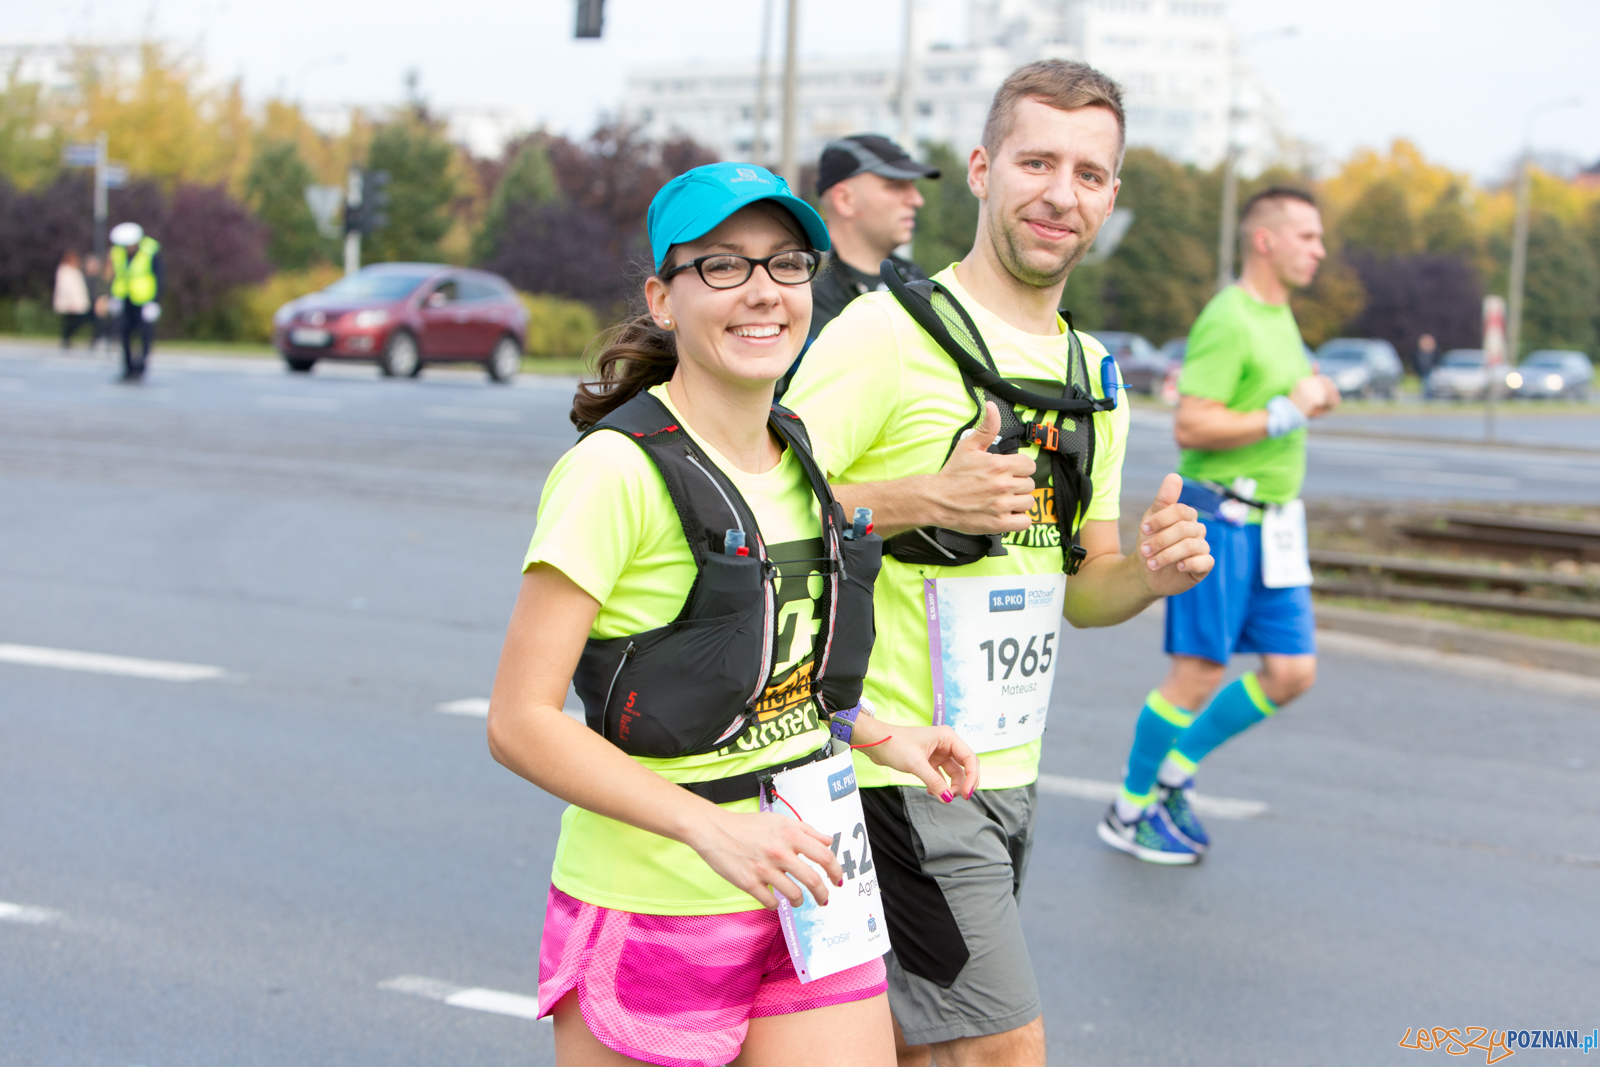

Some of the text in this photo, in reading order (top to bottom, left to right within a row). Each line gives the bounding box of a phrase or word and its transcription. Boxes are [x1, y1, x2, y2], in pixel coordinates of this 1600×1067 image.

[992, 594, 1022, 606] 18. PKO
[979, 632, 1055, 682] 1965
[1001, 682, 1037, 696] Mateusz
[626, 691, 638, 708] 5
[832, 780, 844, 793] 18.
[826, 932, 850, 949] posir
